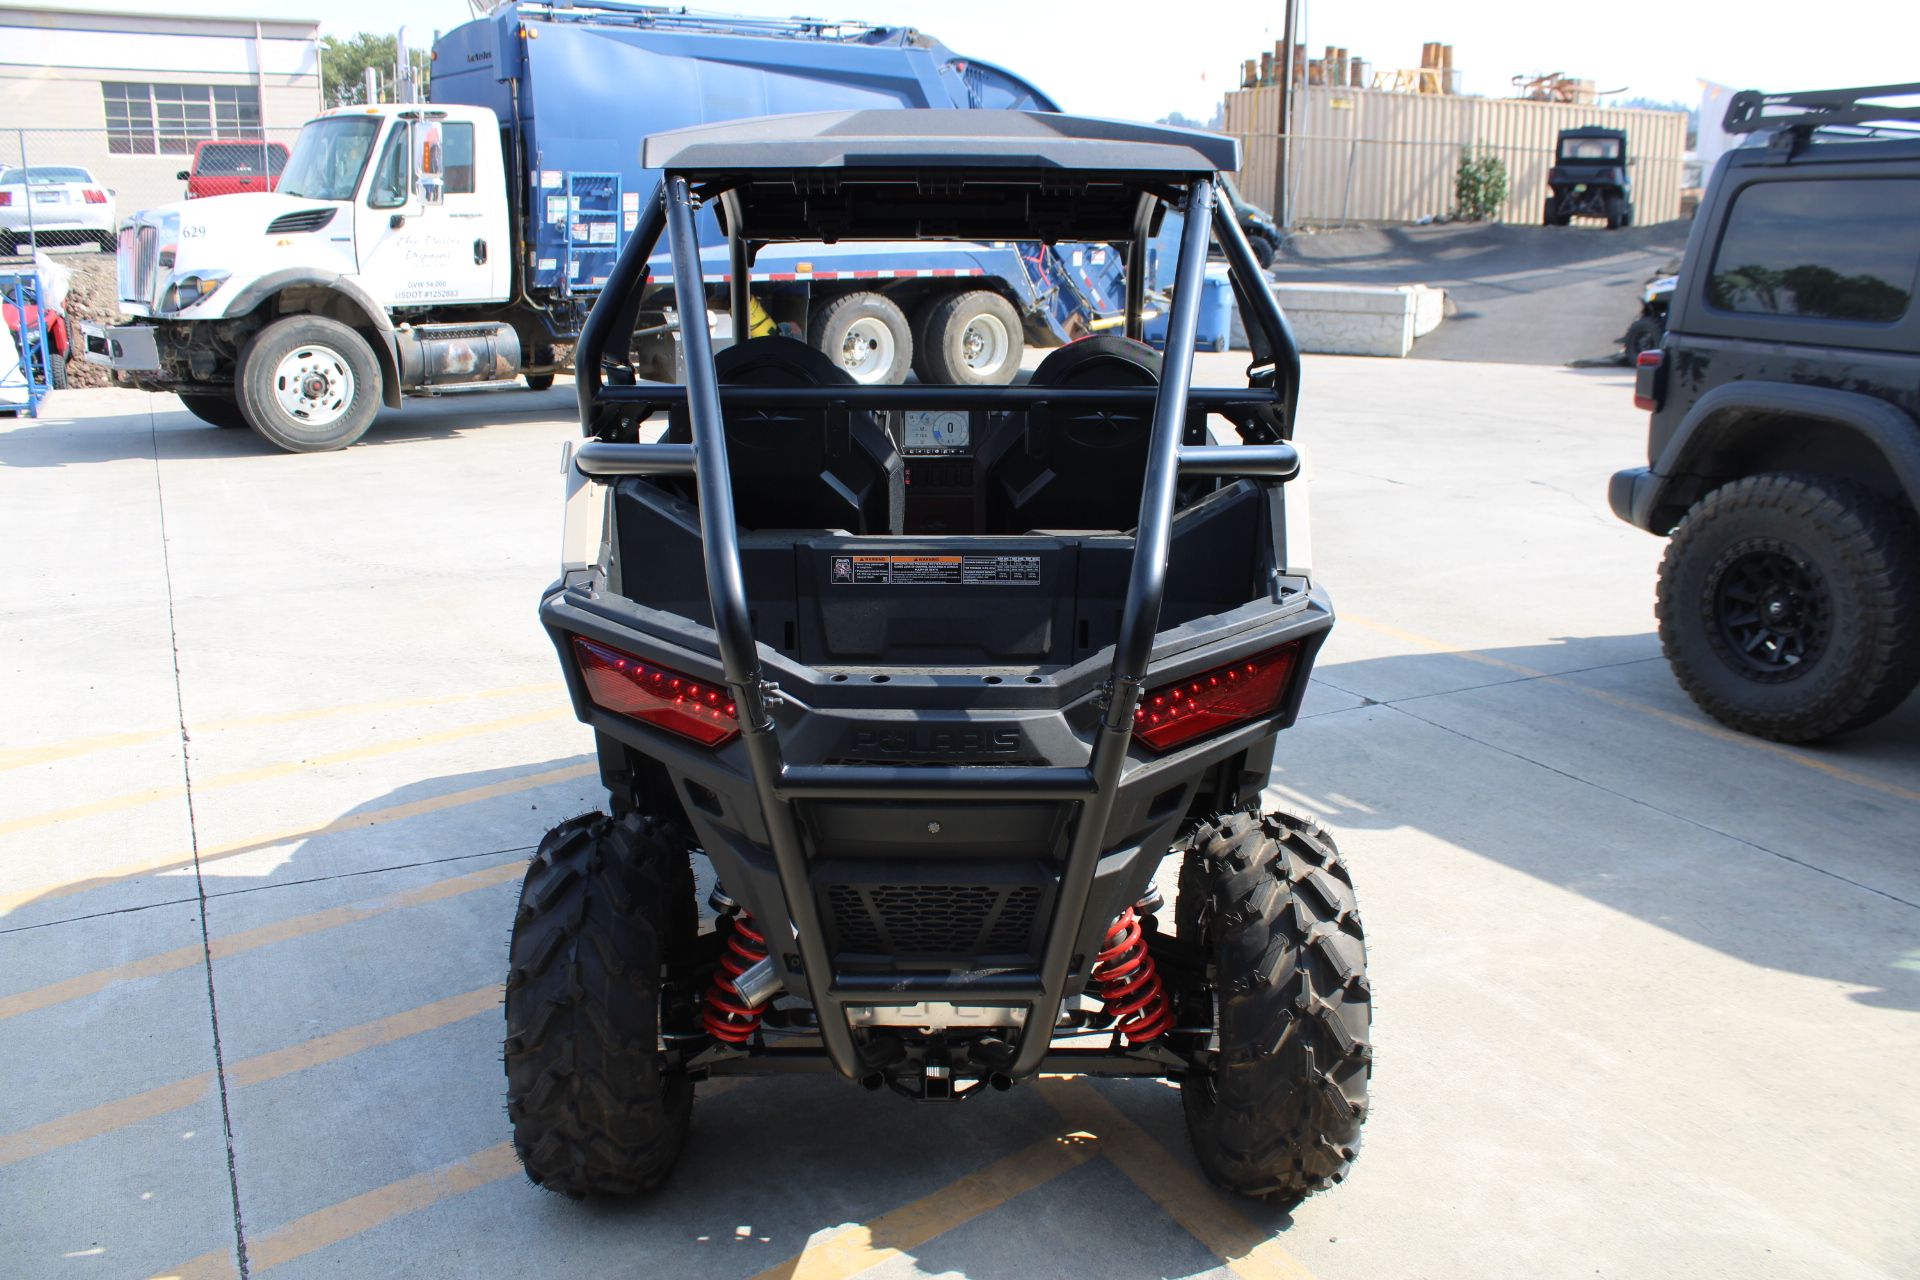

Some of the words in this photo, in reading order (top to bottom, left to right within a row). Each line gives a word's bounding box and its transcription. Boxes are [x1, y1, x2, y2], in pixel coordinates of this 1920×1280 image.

[182, 224, 206, 240] 629
[395, 290, 422, 299] USDOT
[850, 728, 1021, 754] POLARIS
